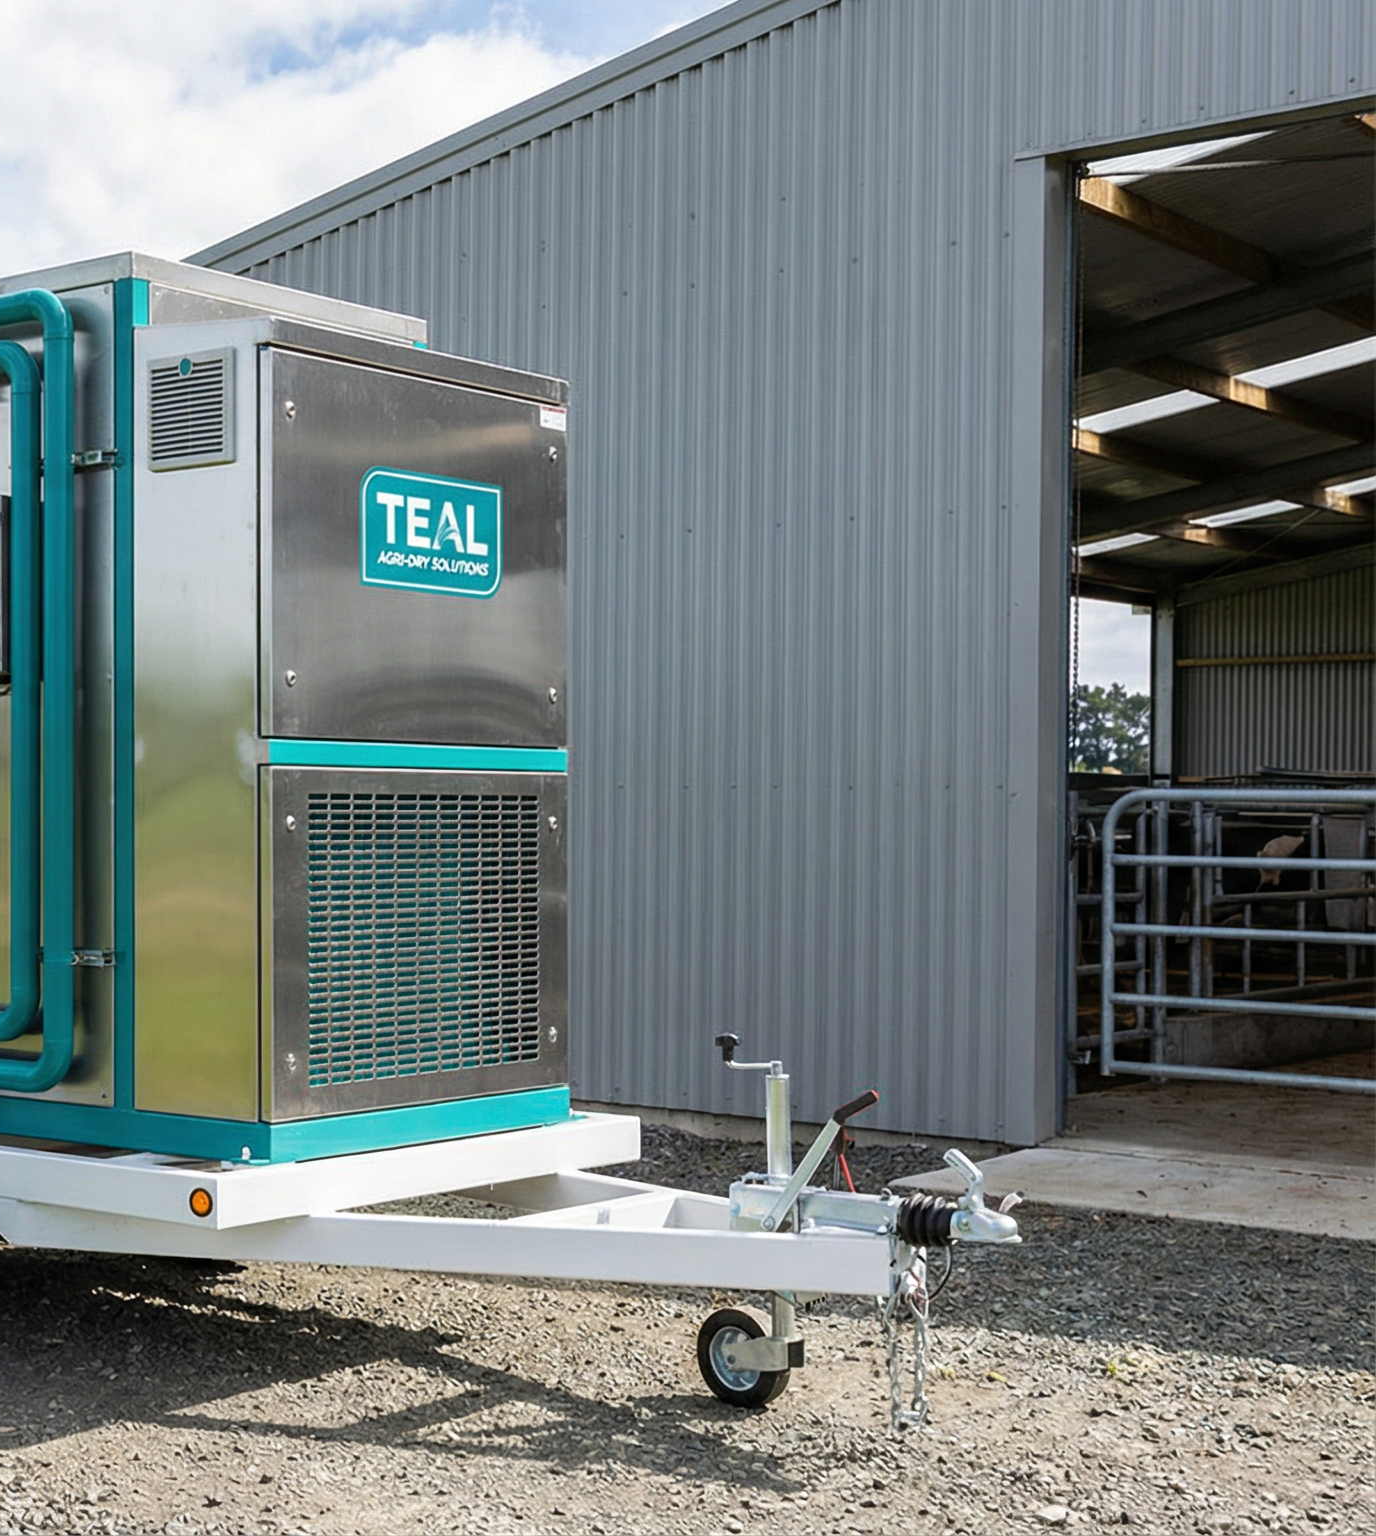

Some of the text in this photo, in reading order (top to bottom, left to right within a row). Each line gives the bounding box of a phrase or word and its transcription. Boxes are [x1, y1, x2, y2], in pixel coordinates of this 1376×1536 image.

[376, 491, 489, 556] TEAL
[377, 550, 489, 576] AGRI-DRY SOLUTIONS
